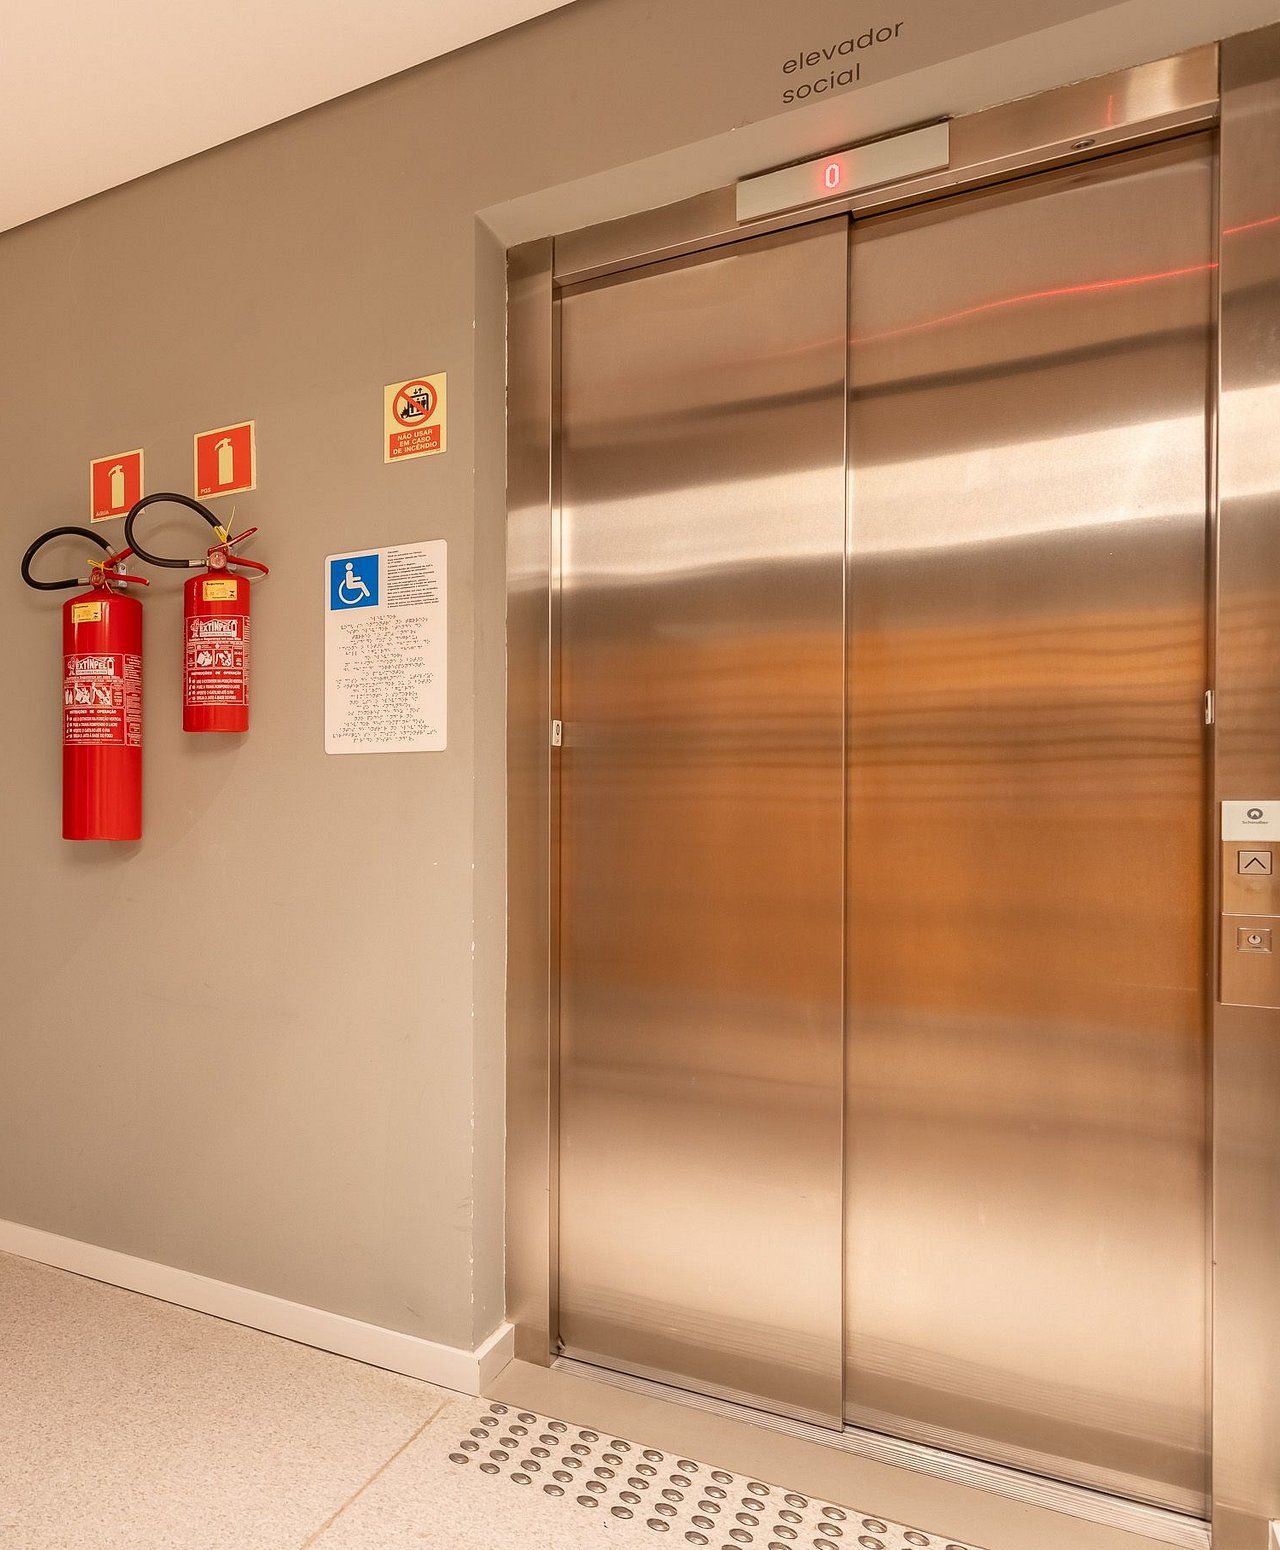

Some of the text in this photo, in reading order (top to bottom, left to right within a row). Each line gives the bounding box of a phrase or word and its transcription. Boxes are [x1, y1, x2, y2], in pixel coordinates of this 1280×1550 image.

[782, 20, 905, 75] elevador
[782, 63, 861, 104] social
[824, 162, 840, 189] 0
[412, 436, 431, 444] CASO
[414, 429, 433, 437] USAR
